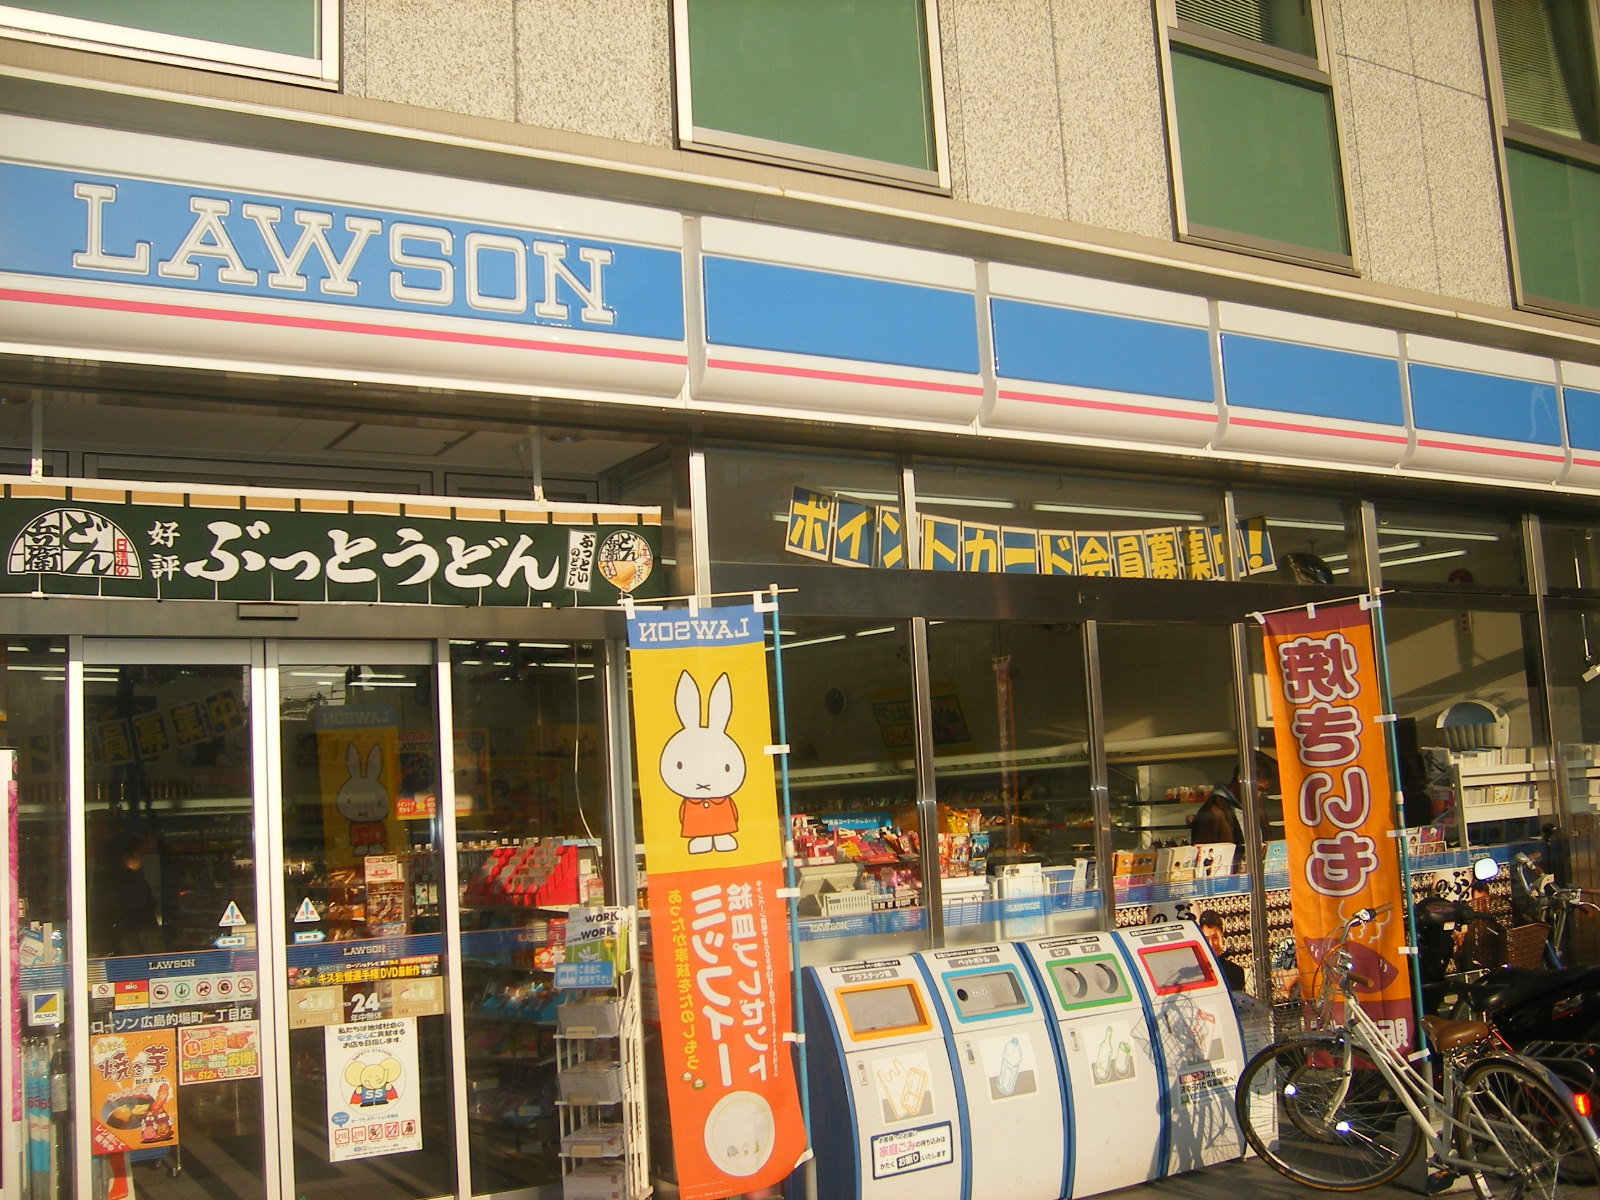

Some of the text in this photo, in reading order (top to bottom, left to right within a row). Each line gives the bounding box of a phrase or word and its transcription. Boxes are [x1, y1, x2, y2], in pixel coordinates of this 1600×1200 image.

[73, 182, 615, 326] LAWSON
[147, 520, 181, 582] 好評
[184, 520, 560, 592] ぶっとうどん
[585, 911, 619, 923] WORK
[581, 926, 616, 940] WORK
[343, 944, 386, 956] LAWSON
[148, 957, 196, 970] LAWSON
[957, 956, 991, 966] ペットボトル
[351, 993, 380, 1013] 24
[96, 1045, 169, 1081] 焼き芋
[365, 1089, 383, 1100] SS
